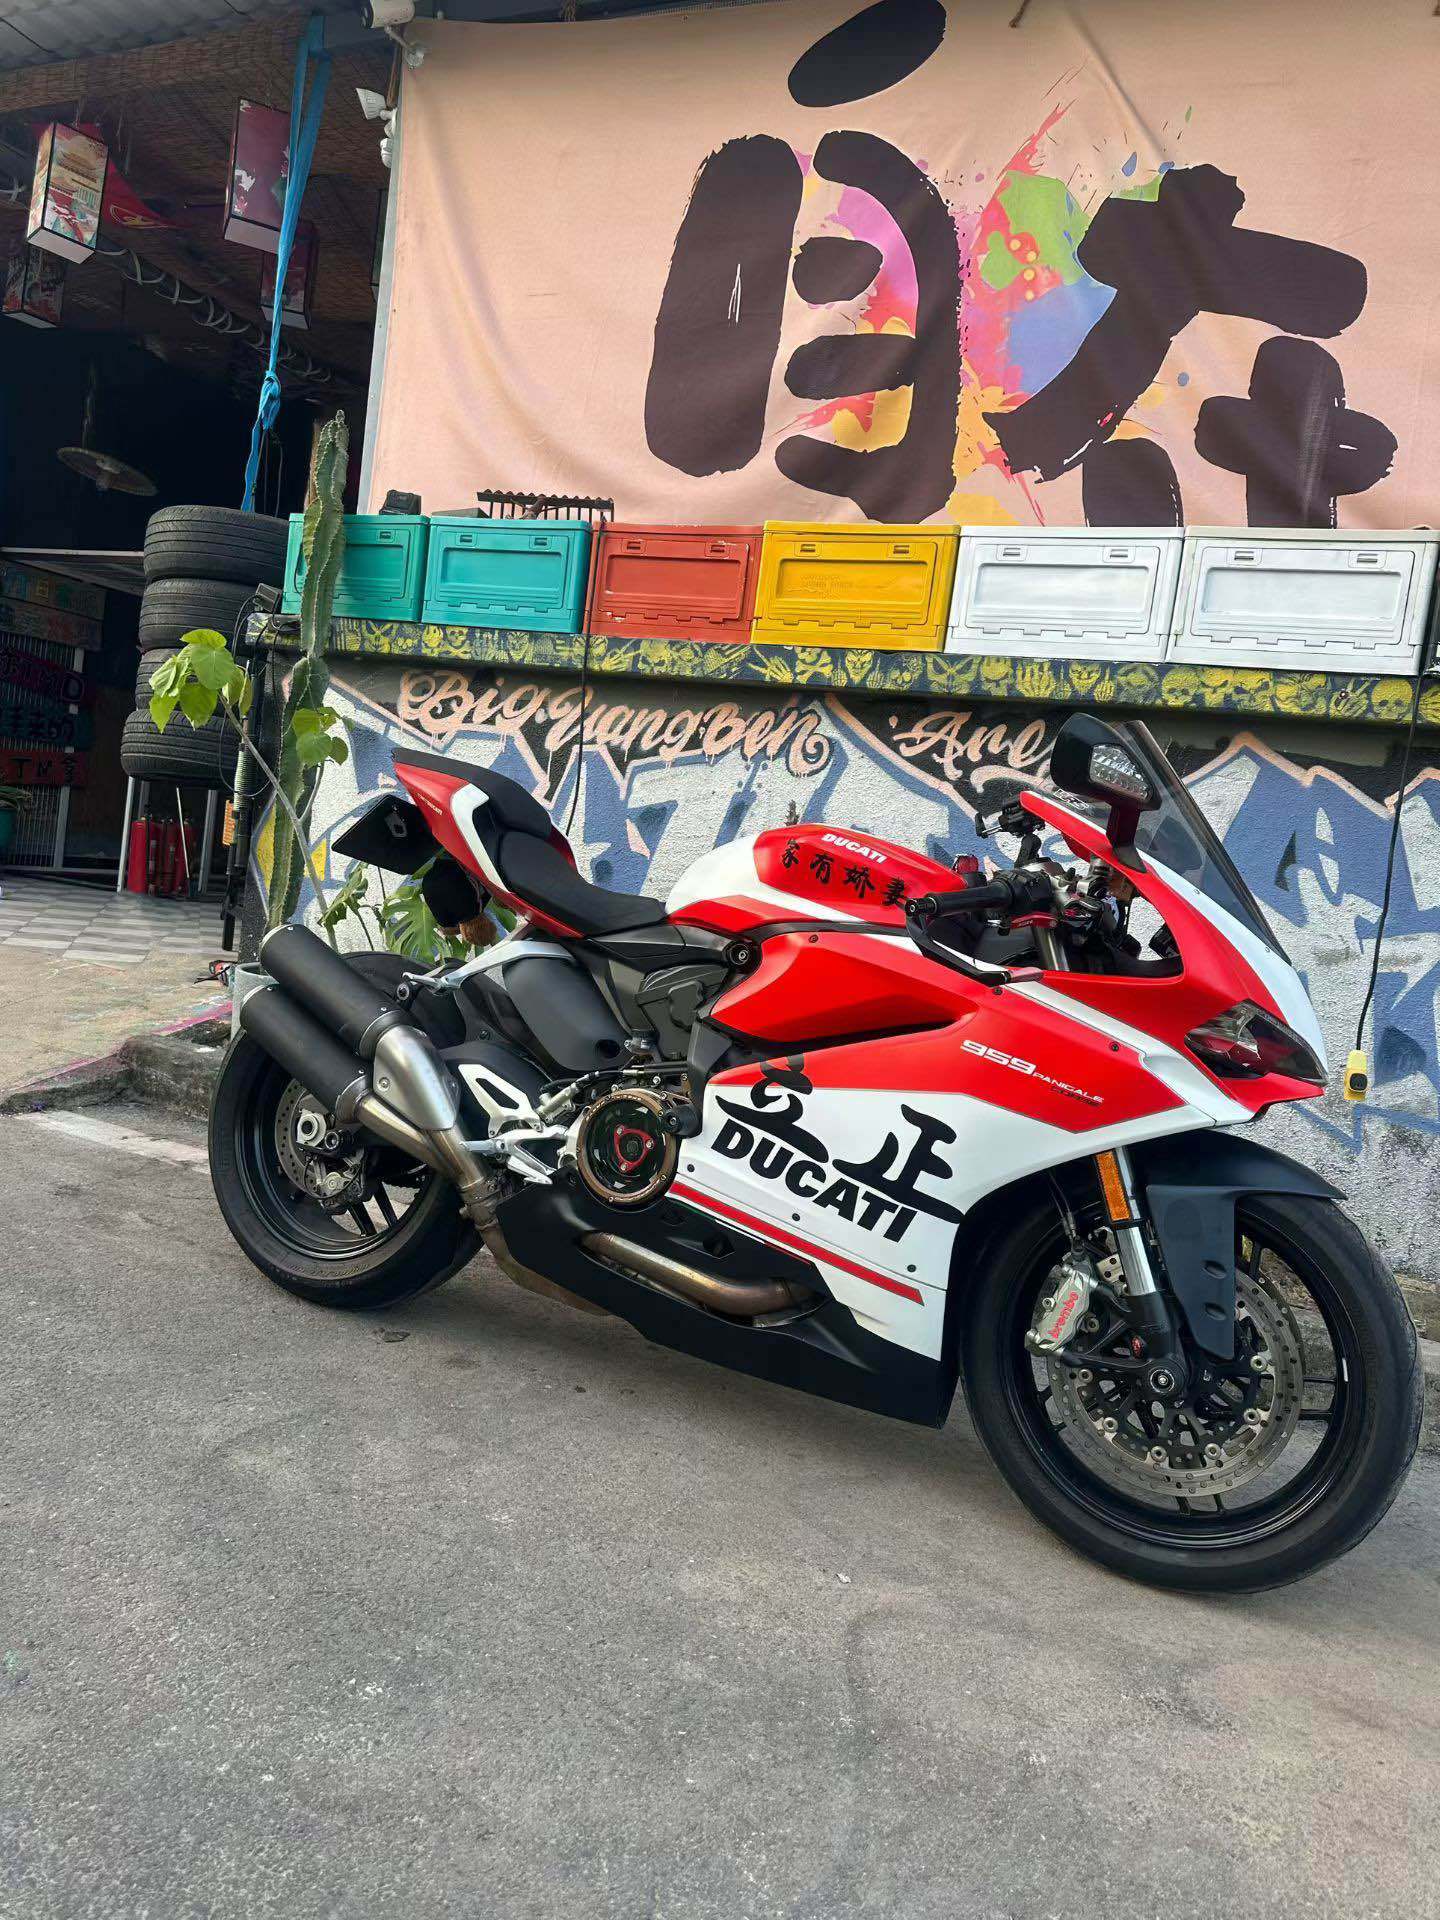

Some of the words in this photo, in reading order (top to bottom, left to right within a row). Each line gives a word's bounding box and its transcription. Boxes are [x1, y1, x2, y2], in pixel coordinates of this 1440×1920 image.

[821, 833, 888, 864] DUCATI
[960, 1039, 1037, 1076] 959
[714, 1054, 965, 1225] 立正
[710, 1119, 919, 1243] DUCATI
[1046, 1291, 1079, 1339] brembo
